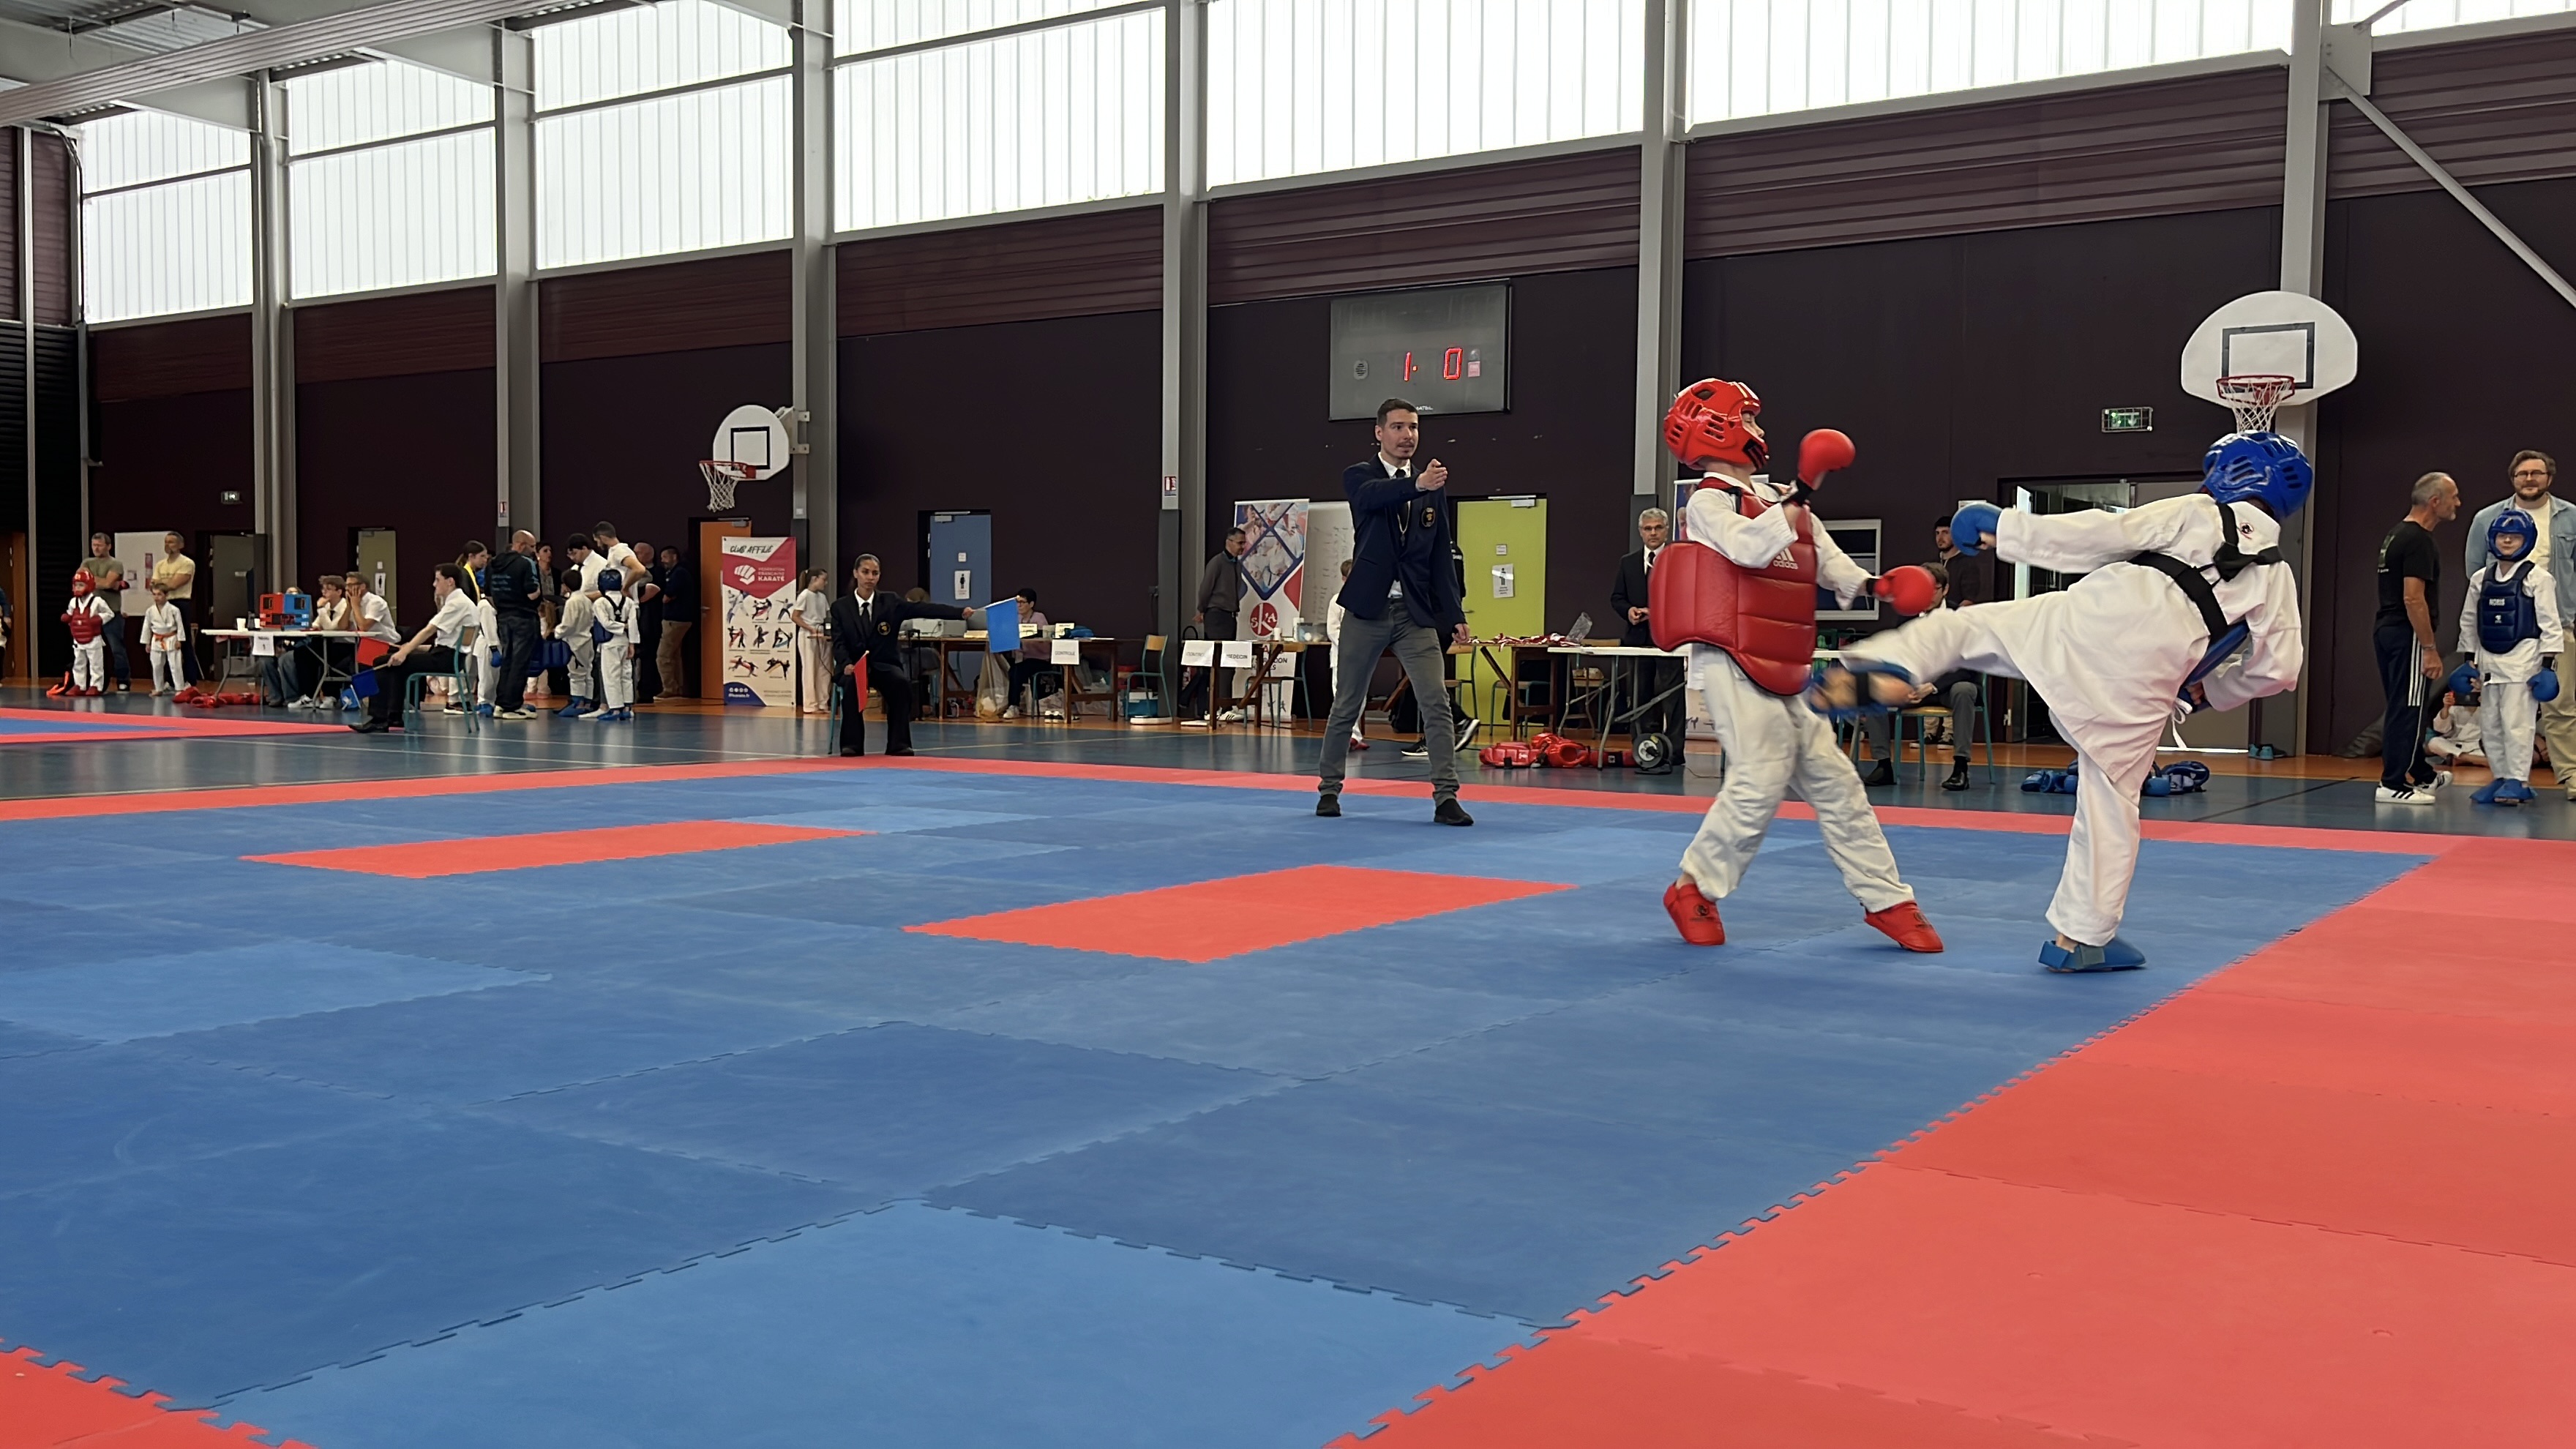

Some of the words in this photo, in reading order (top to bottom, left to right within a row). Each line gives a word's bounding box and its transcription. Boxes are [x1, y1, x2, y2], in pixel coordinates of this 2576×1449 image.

[1444, 348, 1462, 379] 0
[730, 545, 746, 553] CLUB
[1773, 560, 1798, 569] adidas
